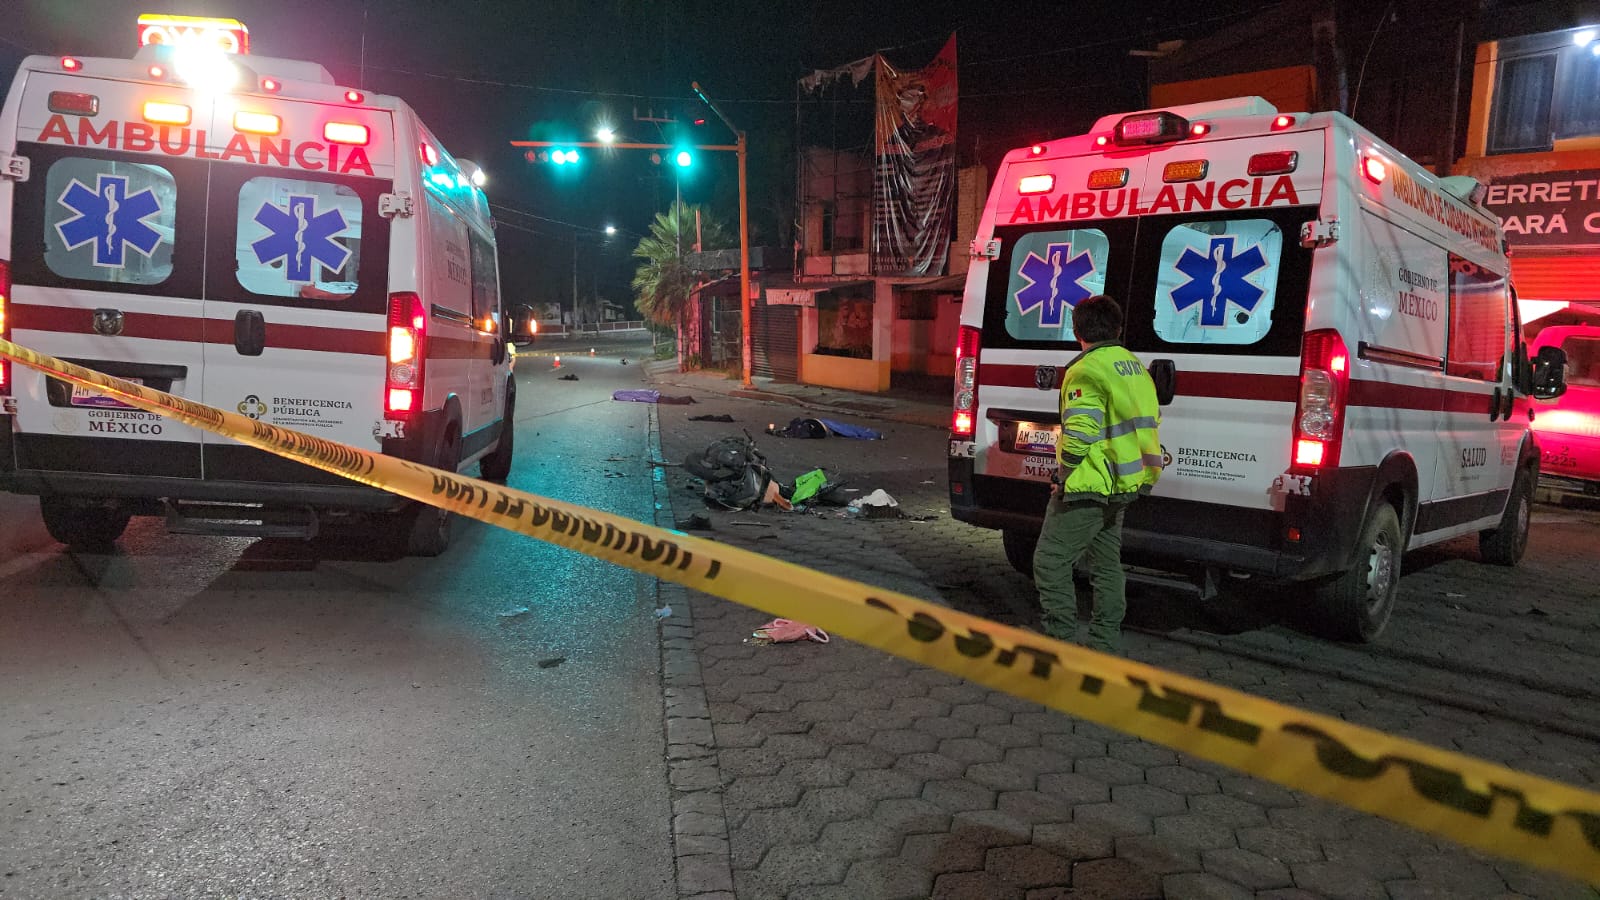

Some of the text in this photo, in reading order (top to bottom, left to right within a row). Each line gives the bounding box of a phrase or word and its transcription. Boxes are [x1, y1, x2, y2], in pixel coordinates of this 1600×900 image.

[37, 113, 375, 176] AMBULANCIA
[1009, 175, 1300, 224] AMBULANCIA
[1391, 164, 1436, 217] AMBULANCIA
[1487, 180, 1600, 205] ERRET
[1398, 267, 1438, 293] GOBIERNO DE
[1398, 287, 1438, 321] MÉXICO
[273, 397, 353, 409] BENEFICENCIA
[273, 405, 321, 417] PÚBLICA
[88, 410, 162, 421] GOBIERNO DE
[88, 418, 162, 435] MÉXICO
[1177, 456, 1223, 469] PÚBLICA
[1178, 447, 1257, 462] BENEFICENCIA
[1461, 447, 1487, 468] SALUD
